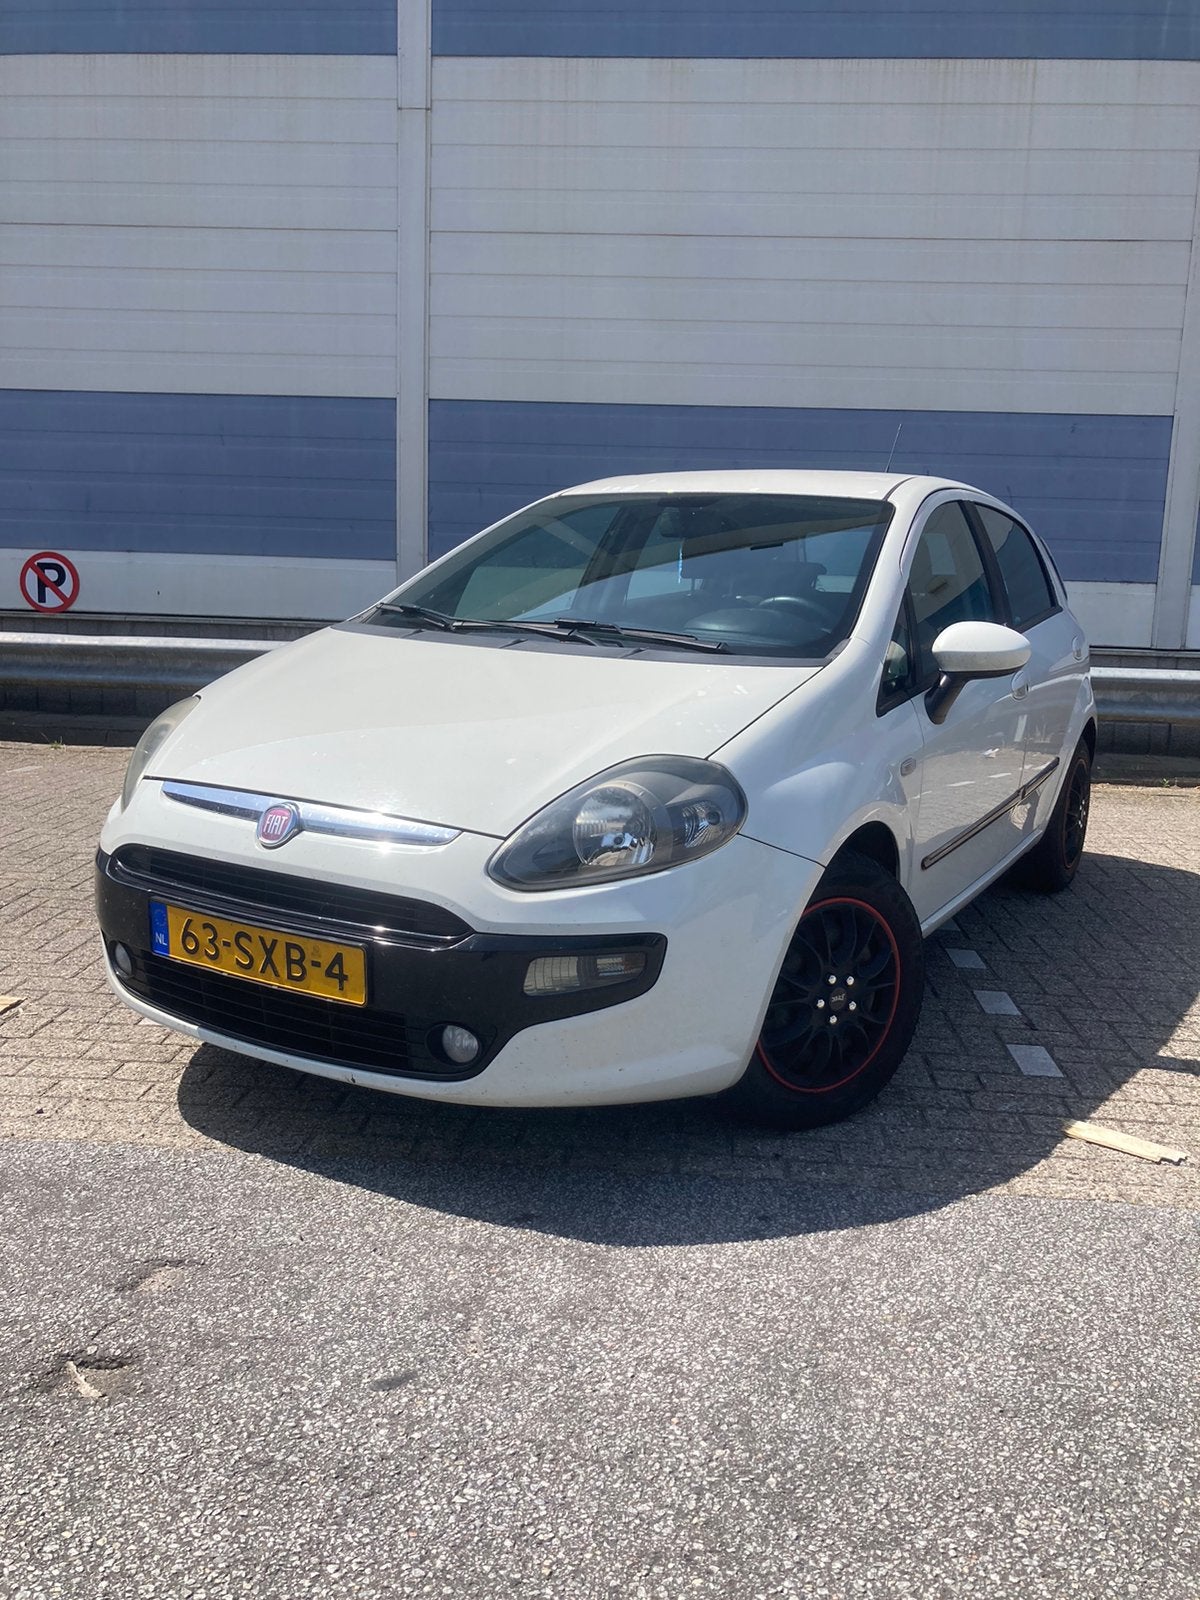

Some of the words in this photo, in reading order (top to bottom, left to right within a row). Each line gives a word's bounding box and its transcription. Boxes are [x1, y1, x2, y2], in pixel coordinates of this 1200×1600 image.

[37, 562, 66, 603] P
[263, 814, 288, 835] FIAT
[155, 933, 168, 946] NL
[181, 917, 348, 991] 63-SXB-4
